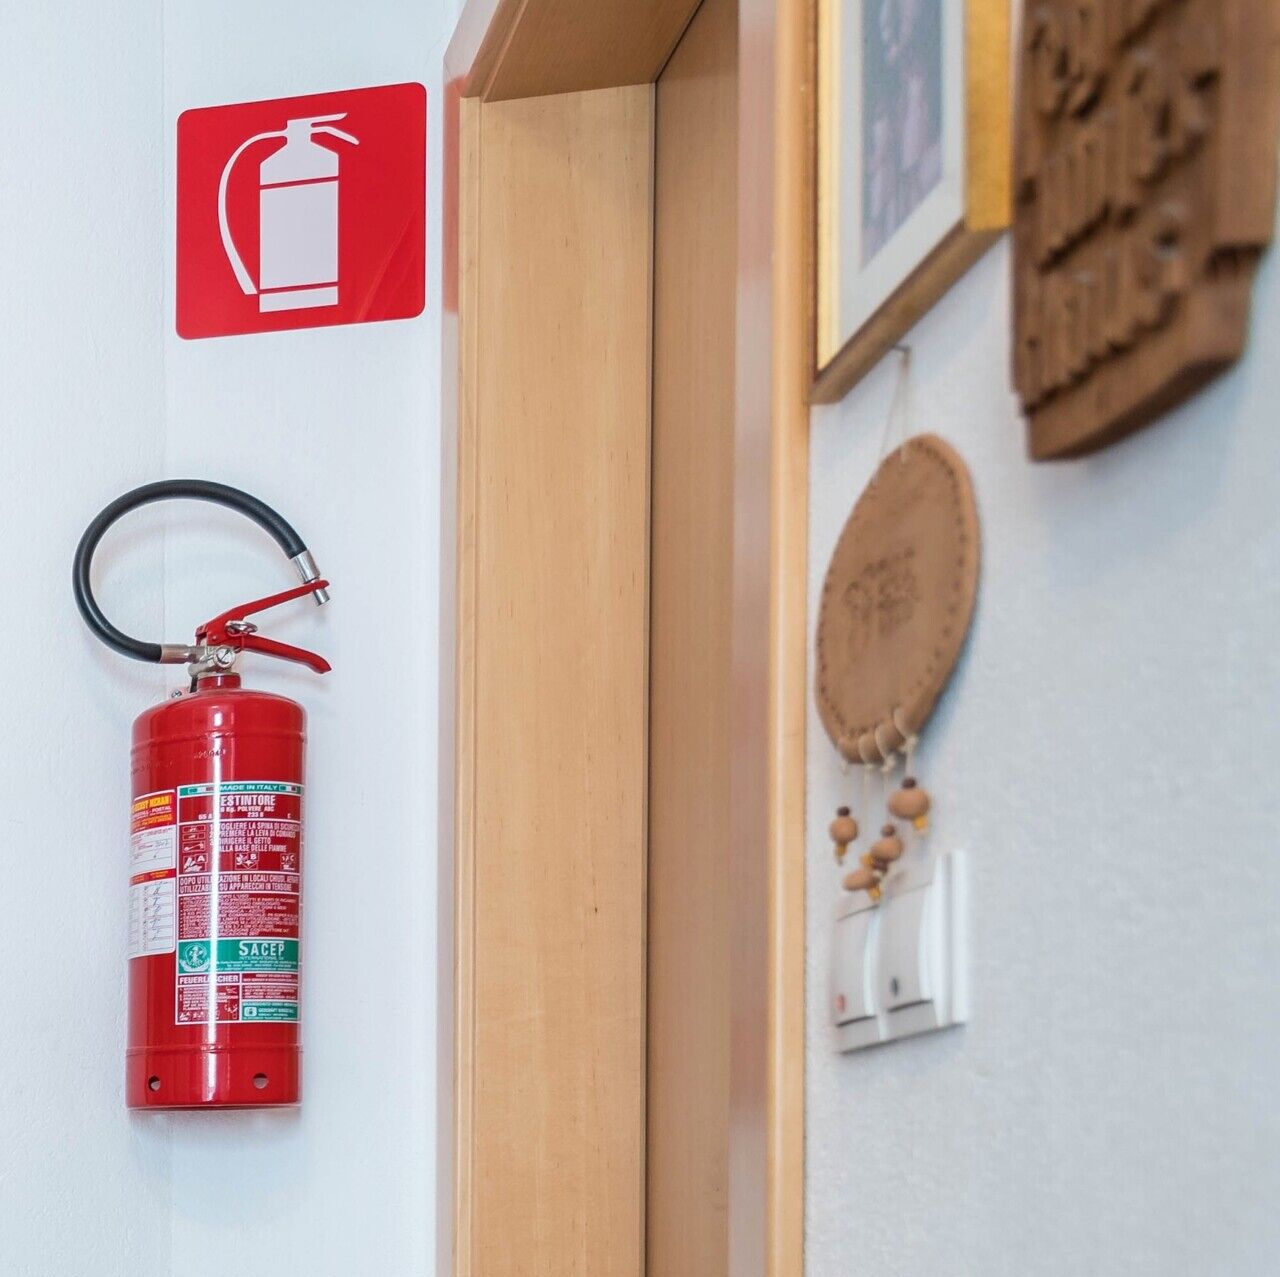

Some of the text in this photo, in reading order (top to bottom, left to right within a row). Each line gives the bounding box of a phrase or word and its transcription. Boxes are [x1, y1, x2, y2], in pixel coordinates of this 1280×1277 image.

[220, 795, 276, 807] ESTINTORE
[219, 822, 247, 831] OGLIERE
[239, 940, 285, 956] SACEP
[179, 975, 239, 985] FEUERLCHER
